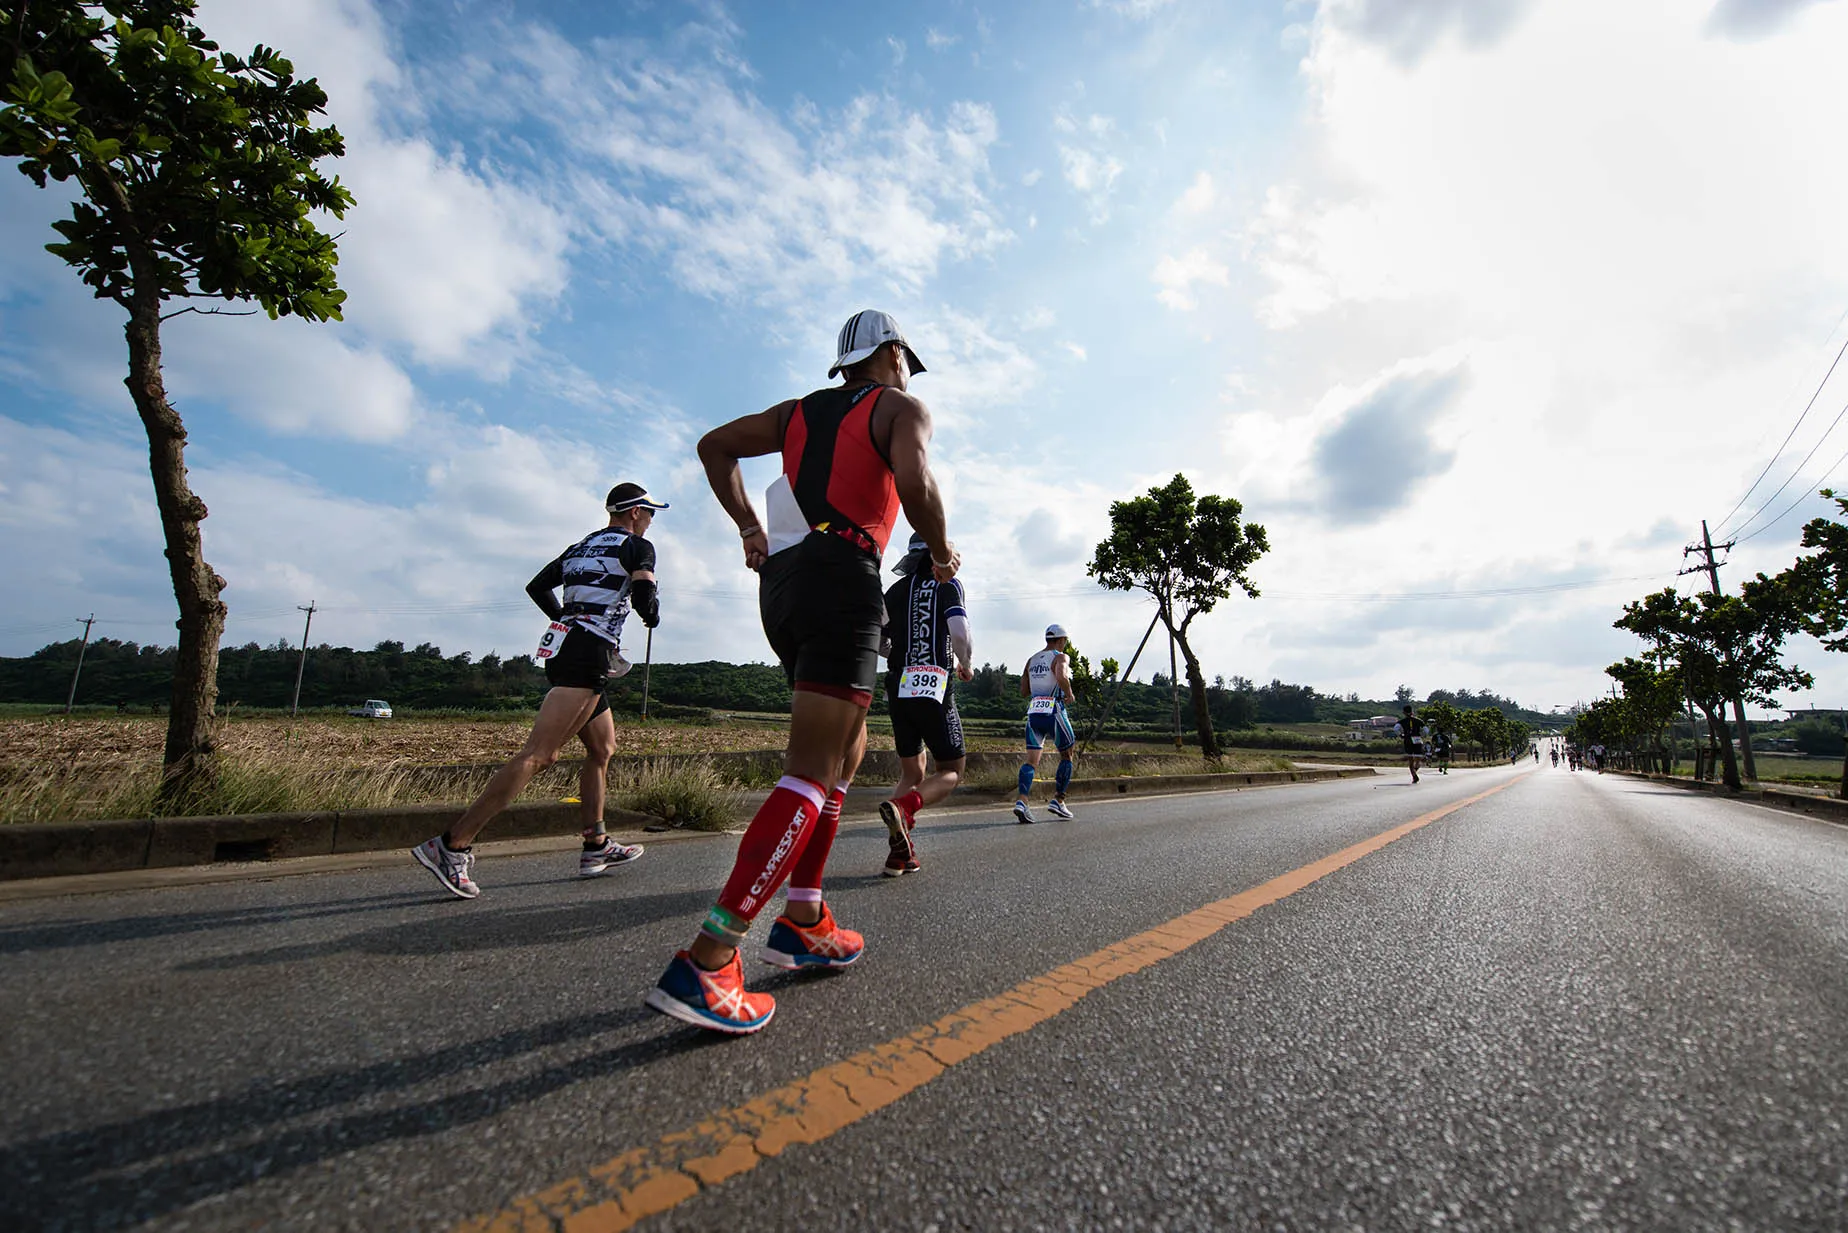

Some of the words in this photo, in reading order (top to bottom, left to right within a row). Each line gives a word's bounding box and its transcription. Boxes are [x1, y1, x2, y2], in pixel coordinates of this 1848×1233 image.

[912, 586, 921, 639] TRIATHLON
[910, 641, 919, 666] TEA
[906, 665, 947, 676] STRONGMAN
[911, 674, 938, 688] 398
[918, 689, 936, 697] JTA
